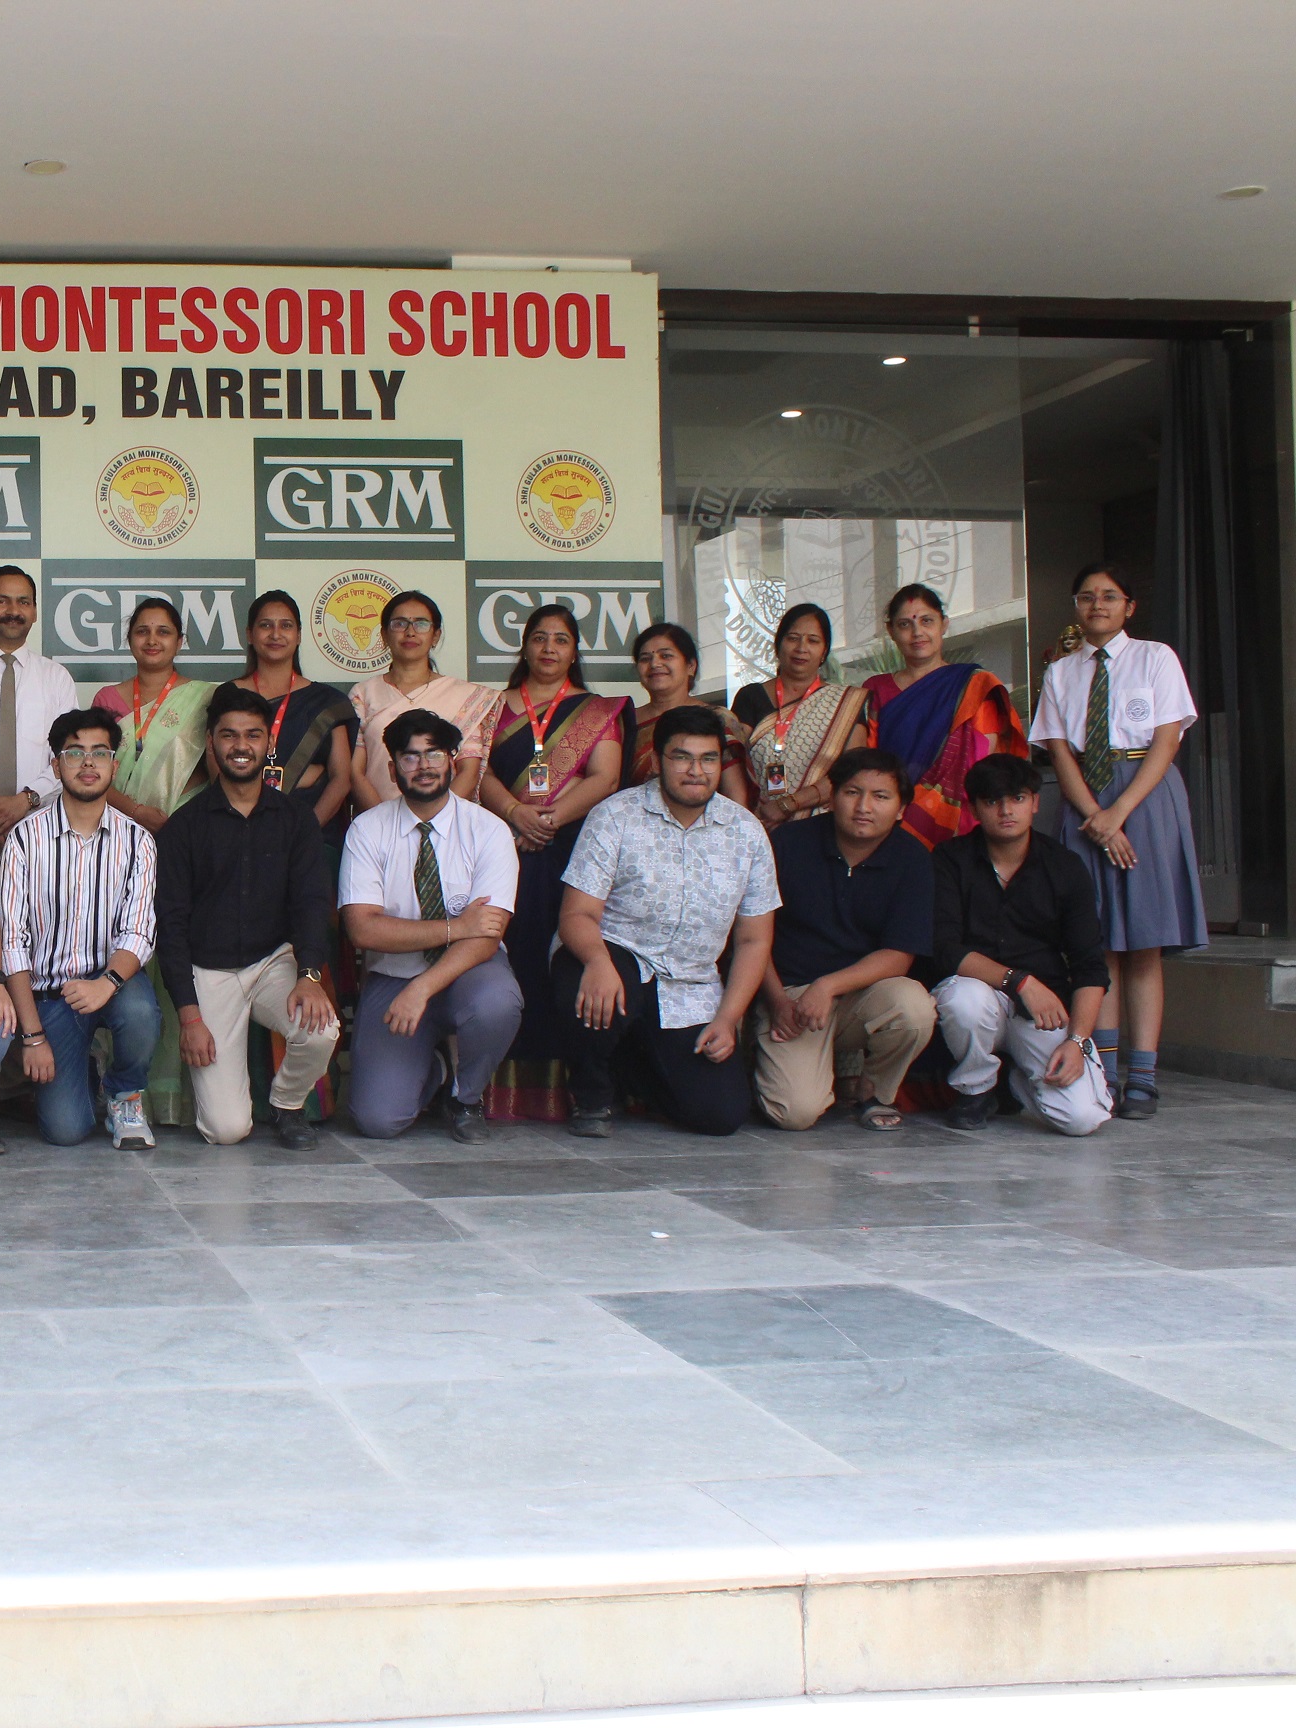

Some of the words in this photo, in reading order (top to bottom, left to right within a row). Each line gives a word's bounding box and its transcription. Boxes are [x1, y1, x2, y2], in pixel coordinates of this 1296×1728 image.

[389, 291, 626, 360] SCHOOL
[121, 367, 406, 420] BAREILLY
[104, 460, 123, 482] GULAB
[123, 453, 136, 463] RAI
[138, 450, 185, 472] MONTESSORI
[100, 484, 109, 501] SHRI
[182, 472, 195, 501] SCHOOL
[521, 487, 529, 504] SHRI
[526, 464, 542, 485] GULAB
[542, 457, 555, 467] RAI
[557, 454, 601, 476] MONTESSORI
[599, 476, 612, 505] SCHOOL
[267, 467, 452, 530] GRM
[108, 520, 130, 540] DOHRA
[158, 520, 188, 544] BAREILLY
[529, 522, 550, 543] DOHRA
[576, 523, 605, 547] BAREILLY
[315, 607, 323, 624] SHRI
[319, 583, 337, 605] GULAB
[337, 575, 350, 586] RAI
[352, 573, 398, 595] MONTESSORI
[725, 613, 780, 664] DOHR
[323, 643, 344, 664] DOHRA
